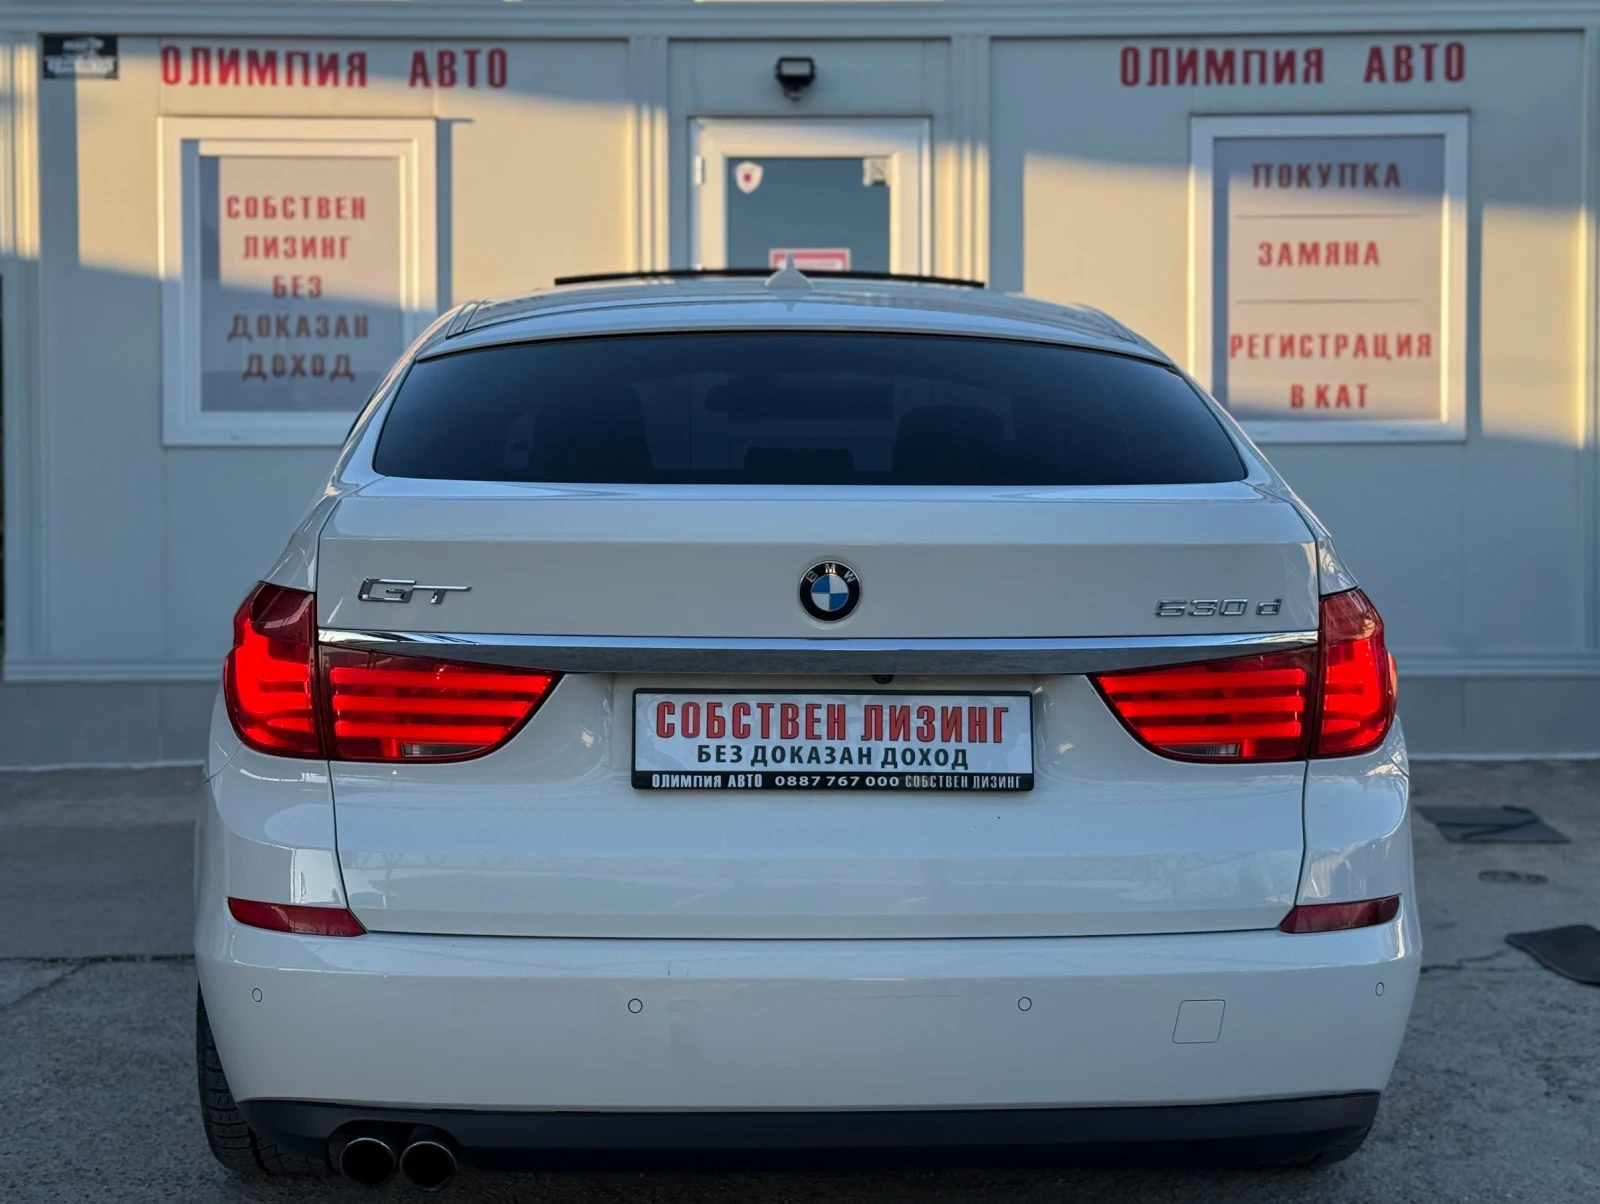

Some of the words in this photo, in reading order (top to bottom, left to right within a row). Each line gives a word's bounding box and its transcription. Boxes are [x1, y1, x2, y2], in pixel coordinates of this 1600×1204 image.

[160, 45, 368, 88] ОЛИМПИЯ
[408, 49, 508, 88] АВТО
[1120, 46, 1324, 87] ОЛИМПИЯ
[1364, 42, 1466, 83] АВТО
[1252, 163, 1401, 189] ПОКУПКА
[226, 196, 366, 220] СОБСТВЕН
[243, 236, 352, 260] ЛИЗИНГ
[1258, 242, 1380, 267] ЗАМЯНА
[272, 276, 323, 299] БЕЗ
[227, 315, 369, 341] ДОКАЗАН
[1229, 333, 1433, 361] РЕГИСТРАЦИЯ
[242, 355, 355, 381] ДОХОД
[1290, 384, 1304, 409] В
[1315, 384, 1368, 408] КАТ
[805, 563, 857, 583] BMW
[358, 578, 472, 604] GT
[1155, 598, 1248, 617] 530
[1256, 598, 1282, 615] d
[656, 701, 847, 741] СОБСТВЕН
[860, 704, 1009, 744] ЛИЗИНГ
[698, 744, 743, 764] БЕЗ
[750, 745, 872, 767] ДОКАЗАН
[880, 748, 969, 770] ДОХОД
[652, 773, 722, 788] ОЛИМПИЯ
[727, 774, 763, 788] АВТО
[775, 774, 820, 787] 0887
[825, 775, 859, 787] 767
[865, 775, 899, 787] 000
[905, 775, 969, 789] СОБСТВЕН
[972, 776, 1021, 789] ЛИЗИНГ
